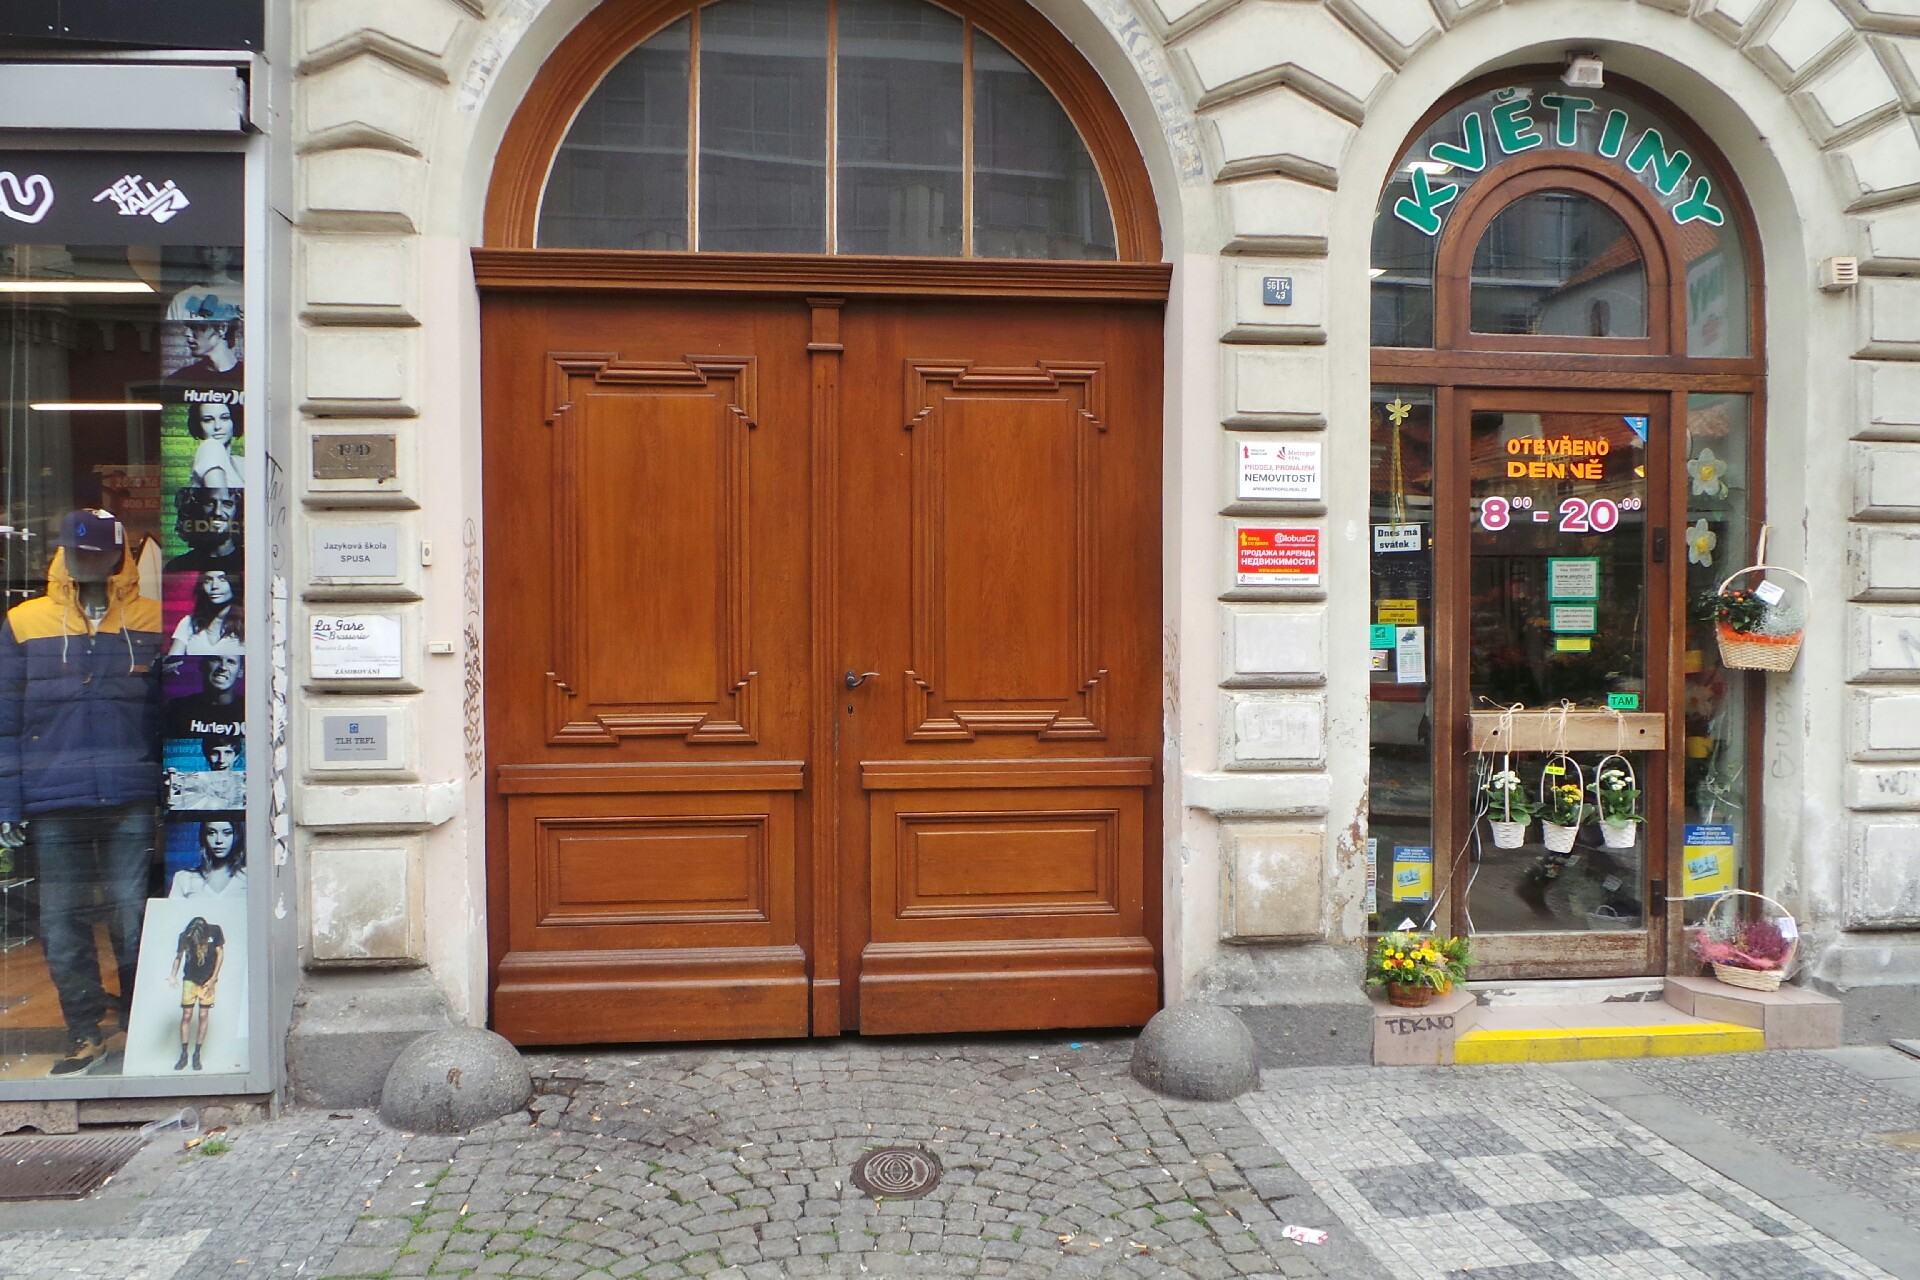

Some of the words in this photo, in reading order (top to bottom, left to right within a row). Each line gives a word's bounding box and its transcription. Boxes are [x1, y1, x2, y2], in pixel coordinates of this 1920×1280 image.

[1394, 87, 1724, 236] KVĚTINY
[184, 389, 232, 404] Hurley
[1507, 435, 1610, 456] OTEVŘENO
[1275, 463, 1315, 471] PRONÁJEM
[1507, 459, 1603, 480] DENNĚ
[1244, 473, 1316, 483] NEMOVITOSTÍ
[1377, 529, 1400, 538] Dnes
[1403, 528, 1418, 536] má
[323, 542, 362, 551] Jazyková
[364, 542, 387, 550] škola
[1379, 540, 1410, 549] svátek
[1241, 549, 1278, 557] ПРОДАЖА
[1286, 549, 1315, 557] АРЕНДА
[340, 555, 371, 563] SPUSA
[1241, 557, 1315, 566] НЕДВИЖИМОСТИ
[314, 619, 331, 631] La
[335, 620, 365, 631] Gare
[328, 630, 369, 640] Brasserie
[335, 667, 380, 675] ZÁSOBOVÁNÍ
[1611, 696, 1634, 706] TAM
[190, 719, 234, 735] Hurley
[335, 737, 352, 745] TLH
[354, 737, 376, 745] TEFL
[1384, 1015, 1454, 1036] TEKNO
